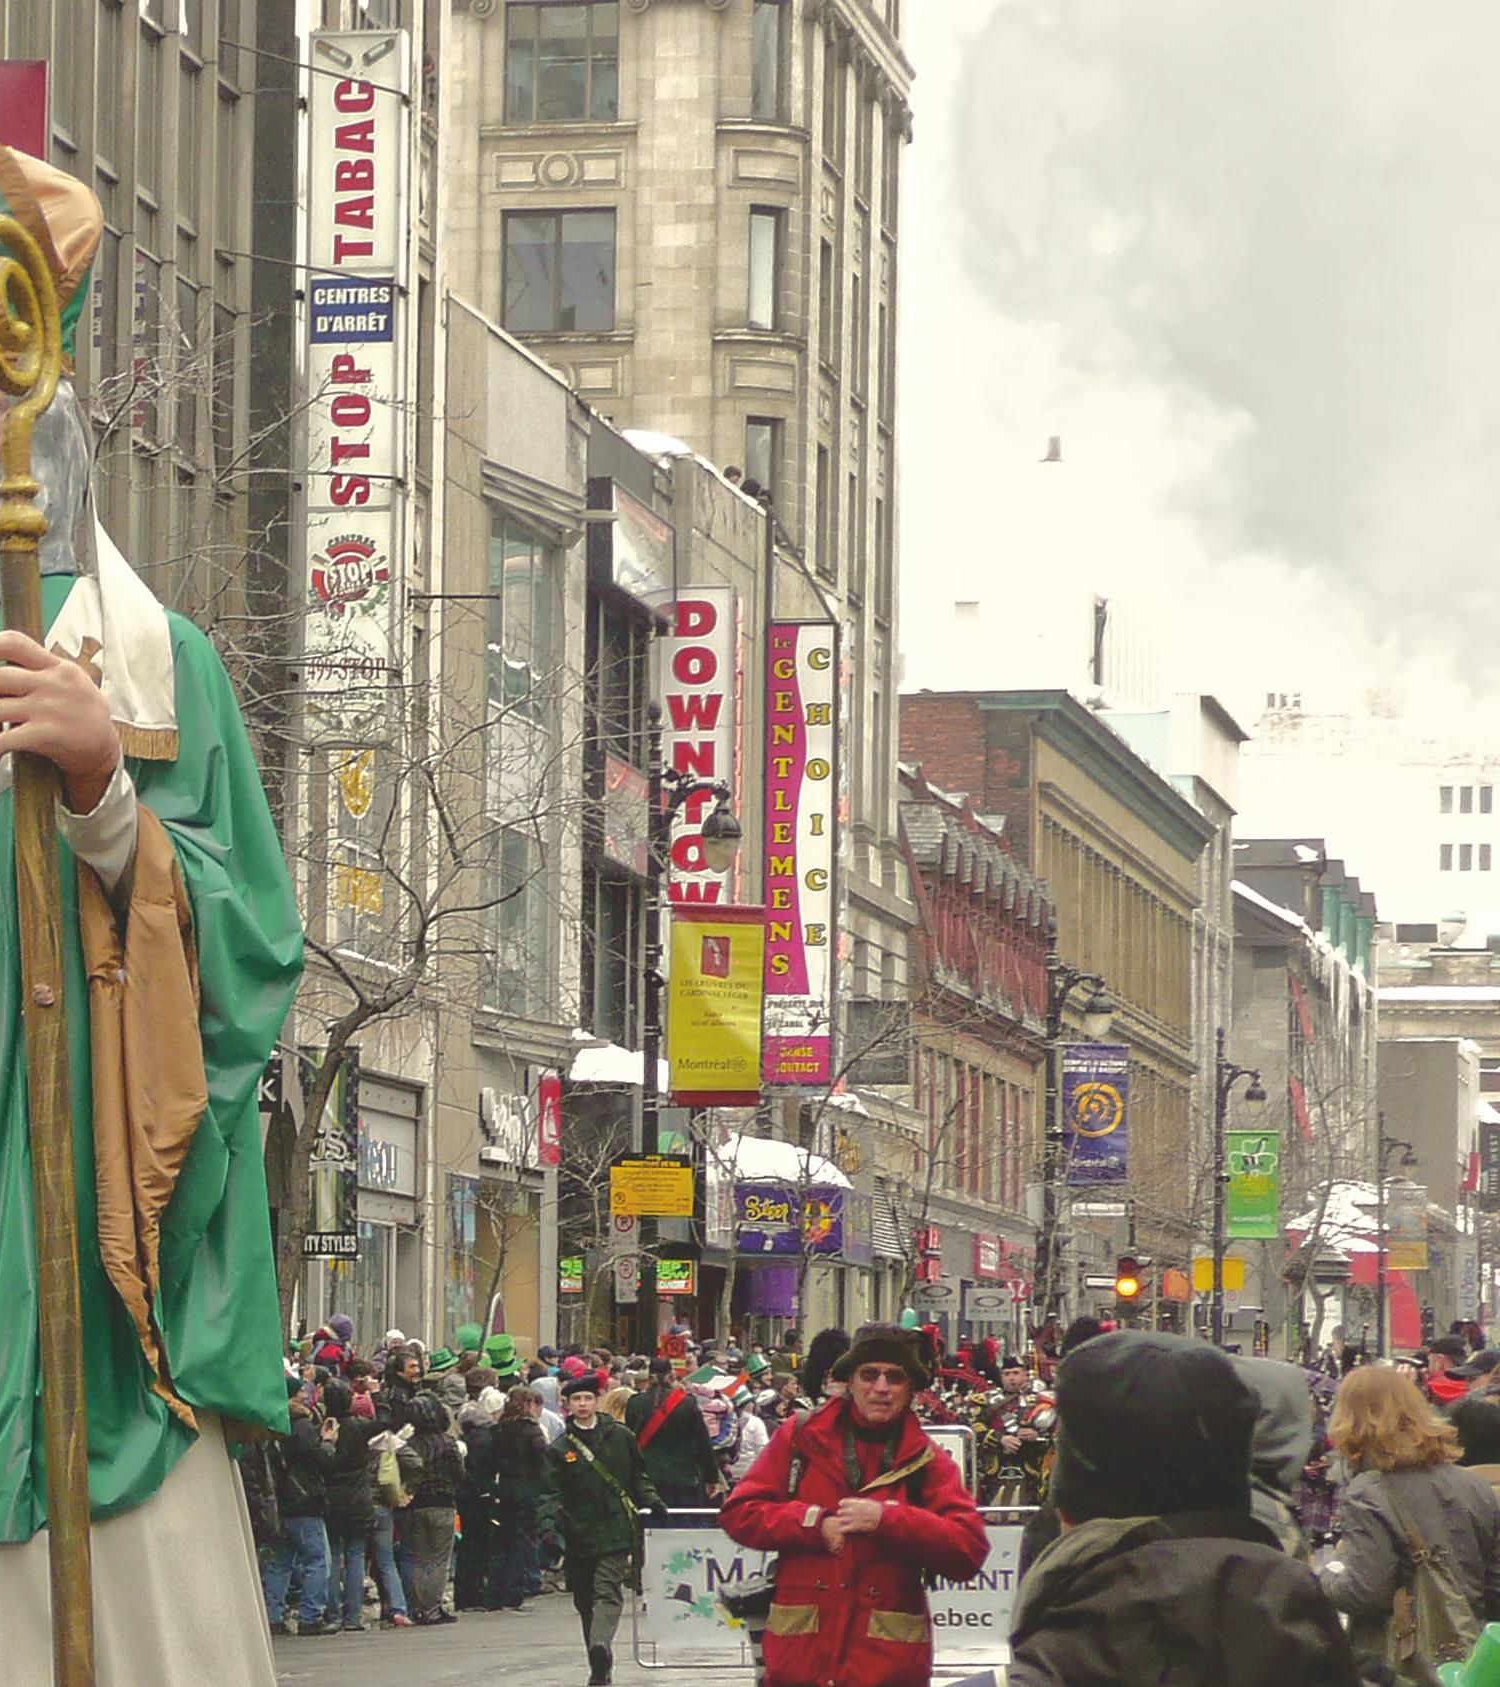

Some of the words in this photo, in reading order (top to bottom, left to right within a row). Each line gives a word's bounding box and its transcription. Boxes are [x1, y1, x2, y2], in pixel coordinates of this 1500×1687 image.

[334, 79, 374, 265] TABAC
[314, 287, 390, 305] CENTRES
[316, 312, 388, 332] D'ARRÊT
[330, 353, 371, 506] STOP
[328, 533, 376, 549] CENTRES
[328, 562, 372, 583] STOP
[773, 637, 792, 649] Le
[804, 646, 831, 947] CHOICE
[768, 657, 795, 976] GENTLEMENS
[678, 1057, 730, 1070] Montréal
[321, 1235, 357, 1253] STYLES
